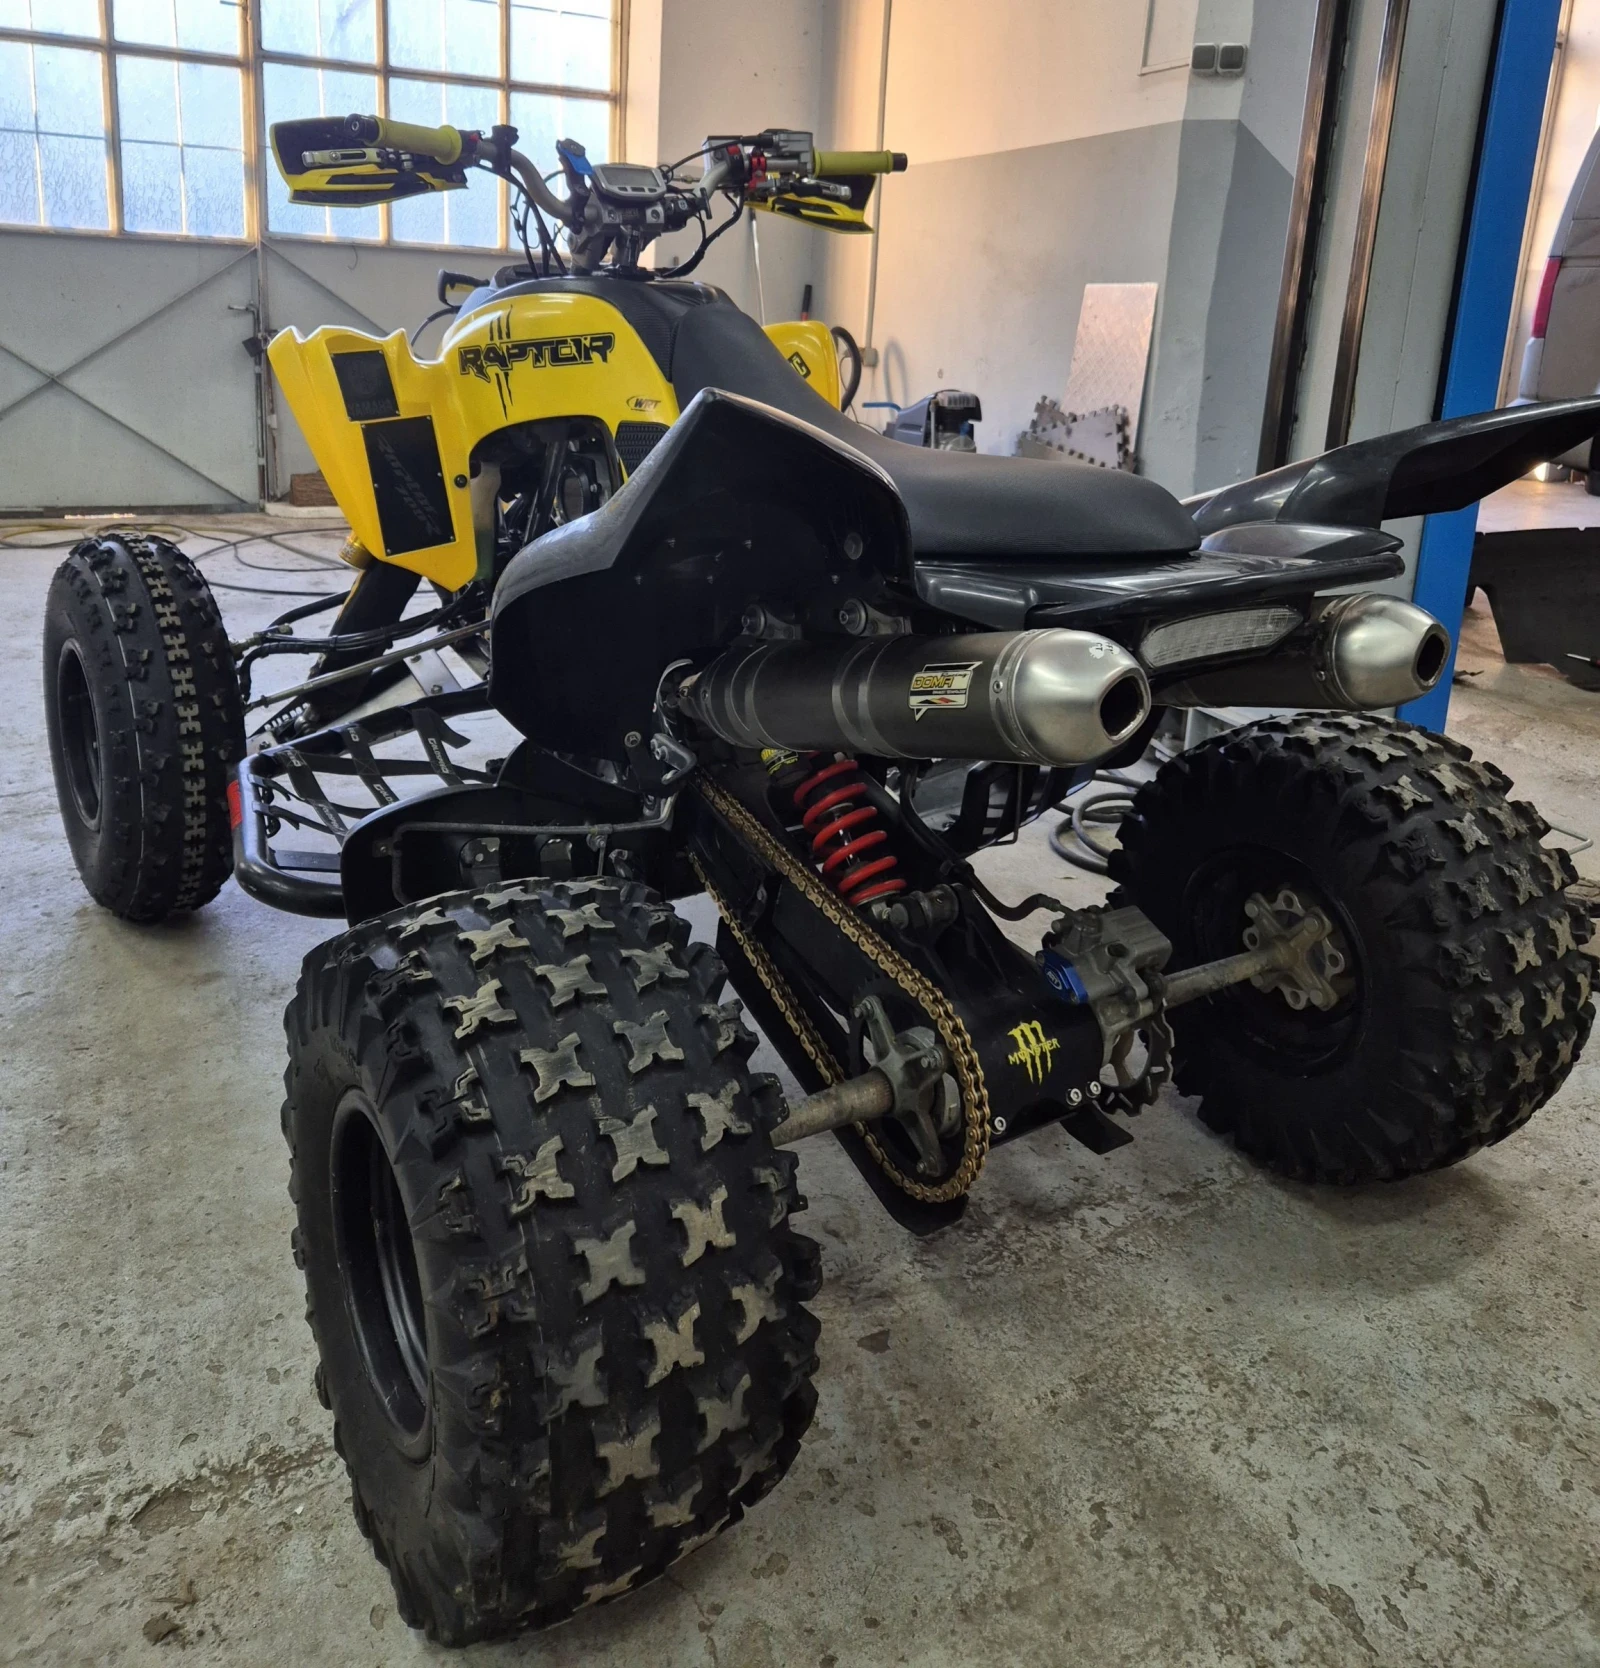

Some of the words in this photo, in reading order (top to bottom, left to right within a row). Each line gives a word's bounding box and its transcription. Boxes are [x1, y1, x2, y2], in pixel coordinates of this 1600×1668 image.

[458, 332, 615, 383] RAPTOR
[912, 676, 954, 689] DOMA
[1008, 1038, 1061, 1065] MONSTER
